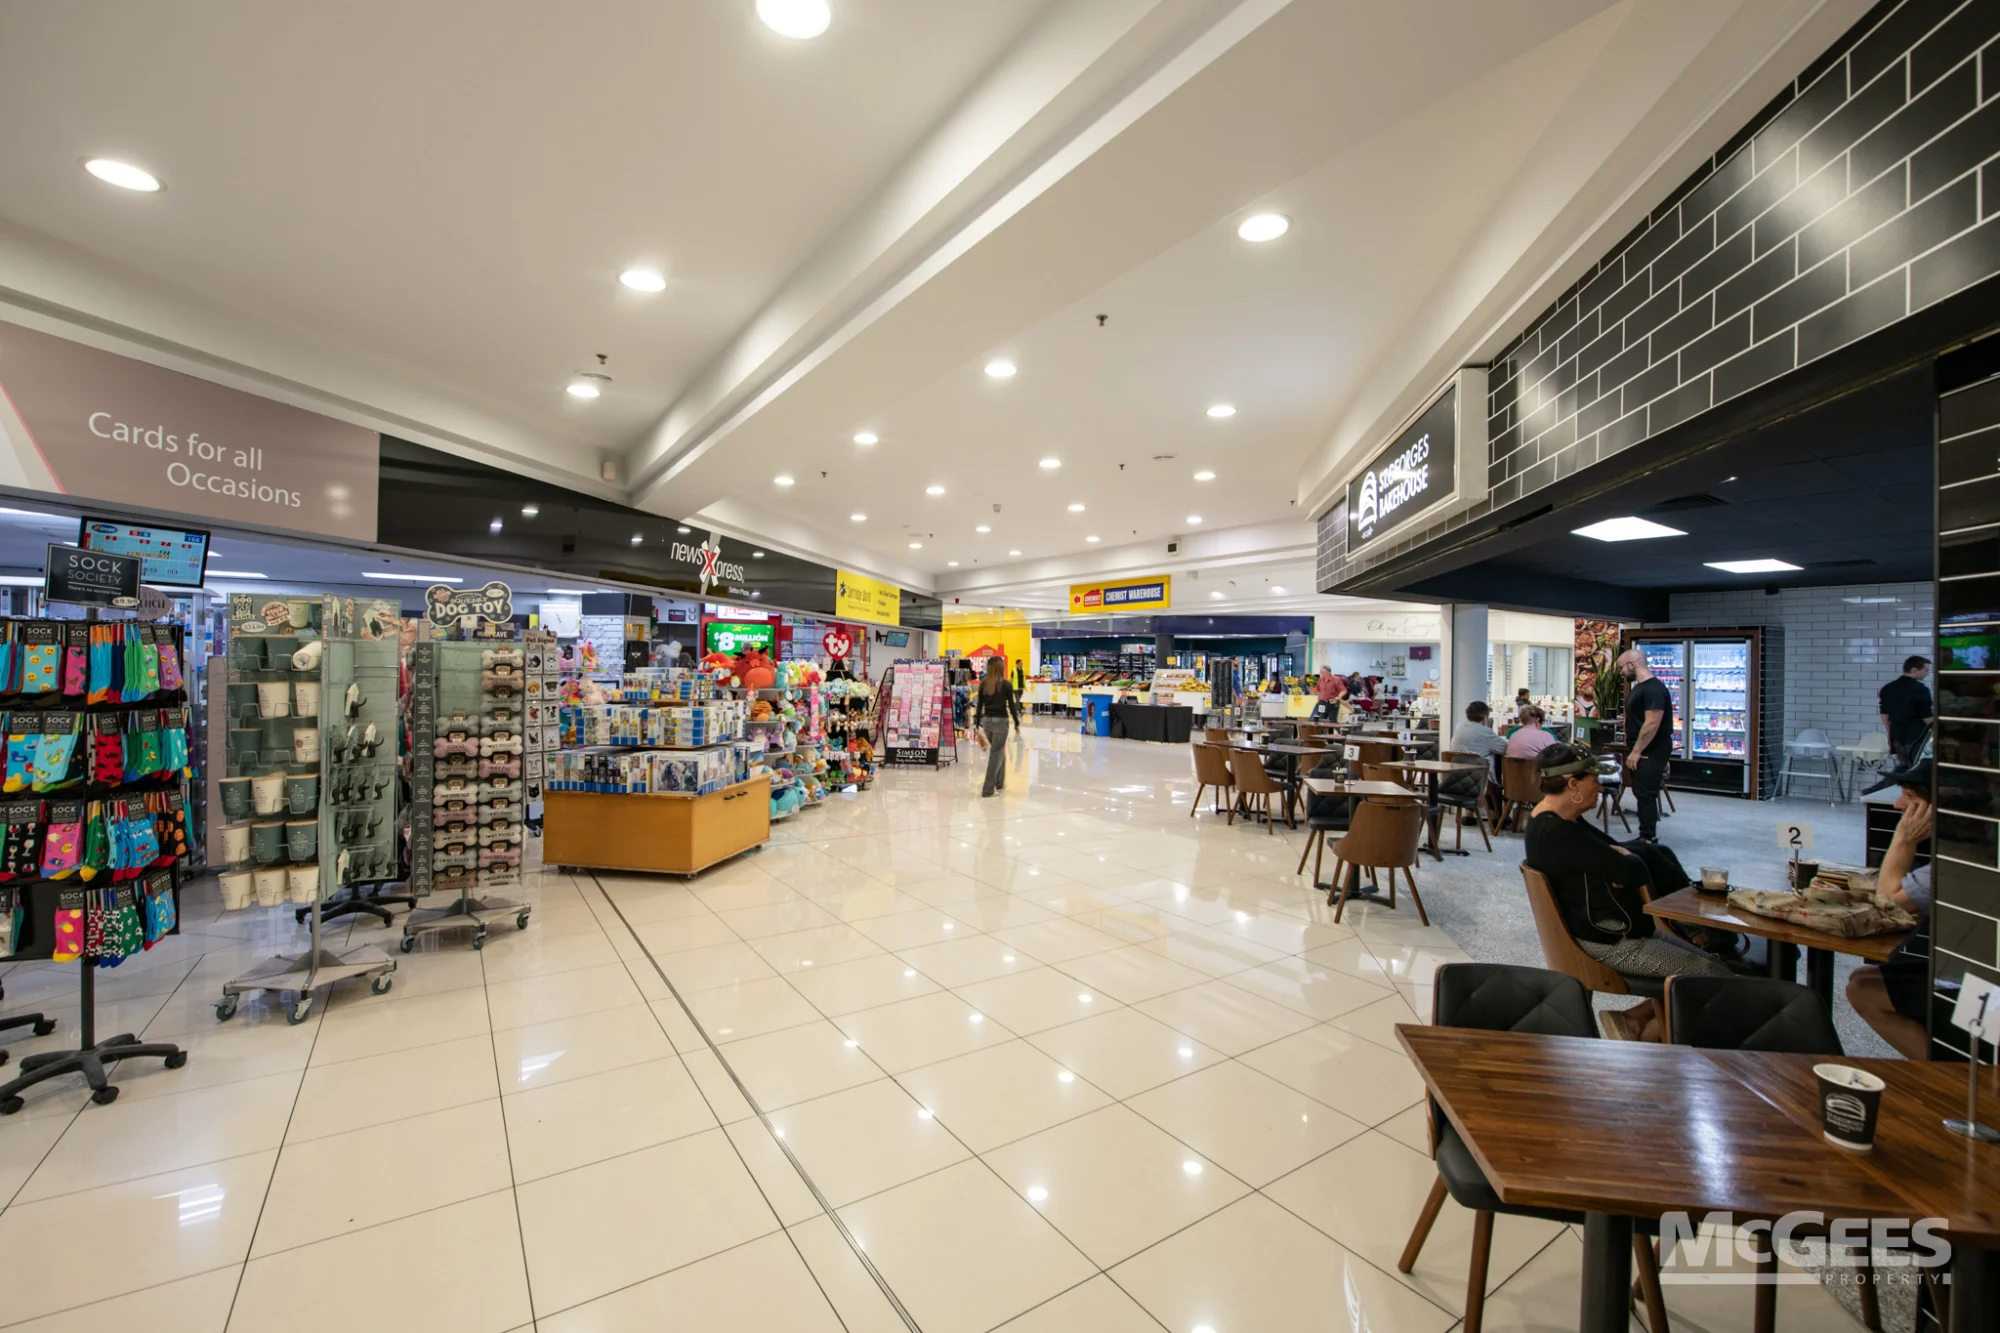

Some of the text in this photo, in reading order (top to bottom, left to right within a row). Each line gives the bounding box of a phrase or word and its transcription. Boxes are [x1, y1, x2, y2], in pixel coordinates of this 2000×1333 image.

[88, 412, 263, 471] Cards for all
[167, 461, 302, 508] Occasions
[68, 555, 123, 575] SOCK
[67, 569, 123, 585] SOCIETY
[1105, 587, 1162, 602] CHEMIST WAREHOUSE
[435, 599, 504, 619] DOG TOY
[825, 634, 850, 657] ty
[896, 748, 928, 756] SIMSON
[1348, 748, 1355, 758] 3
[8, 806, 36, 814] SOCK
[1788, 826, 1802, 844] 2
[60, 892, 84, 900] SOCK
[116, 890, 131, 898] SOCK
[1978, 992, 1990, 1027] 1
